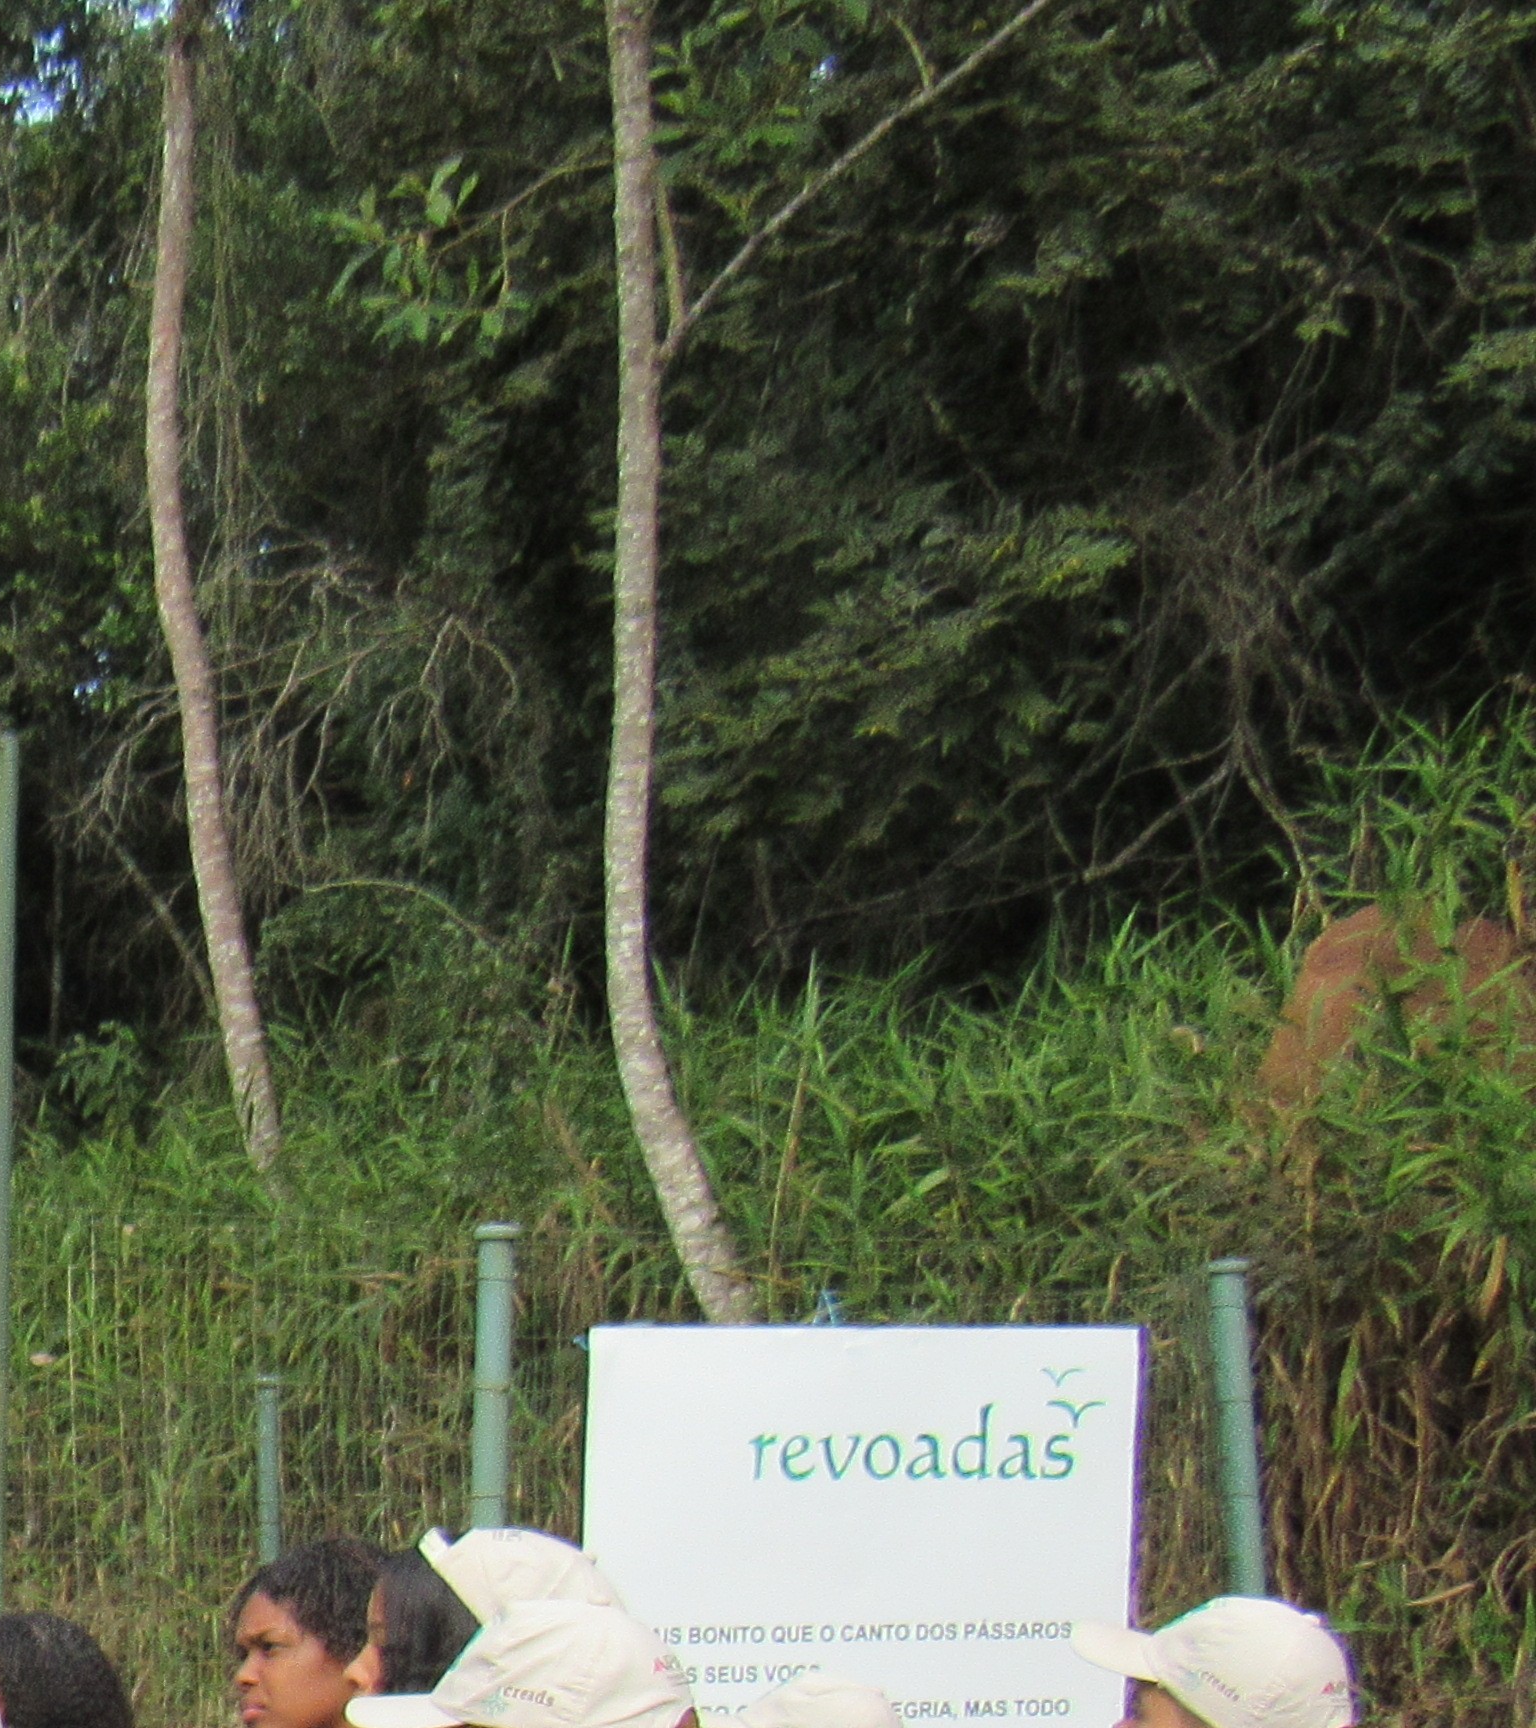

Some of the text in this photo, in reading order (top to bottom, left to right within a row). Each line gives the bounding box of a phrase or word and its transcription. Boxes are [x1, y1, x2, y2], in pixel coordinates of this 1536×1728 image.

[749, 1403, 1077, 1482] revoadas
[688, 1626, 765, 1645] BONITO
[771, 1626, 813, 1645] QUE
[820, 1625, 835, 1642] O
[841, 1624, 910, 1642] CANTO
[916, 1622, 958, 1641] DOS
[964, 1619, 1072, 1640] PÁSSAROS
[704, 1665, 758, 1684] SEUS
[964, 1699, 1009, 1719] MAS
[1013, 1698, 1071, 1718] TODO
